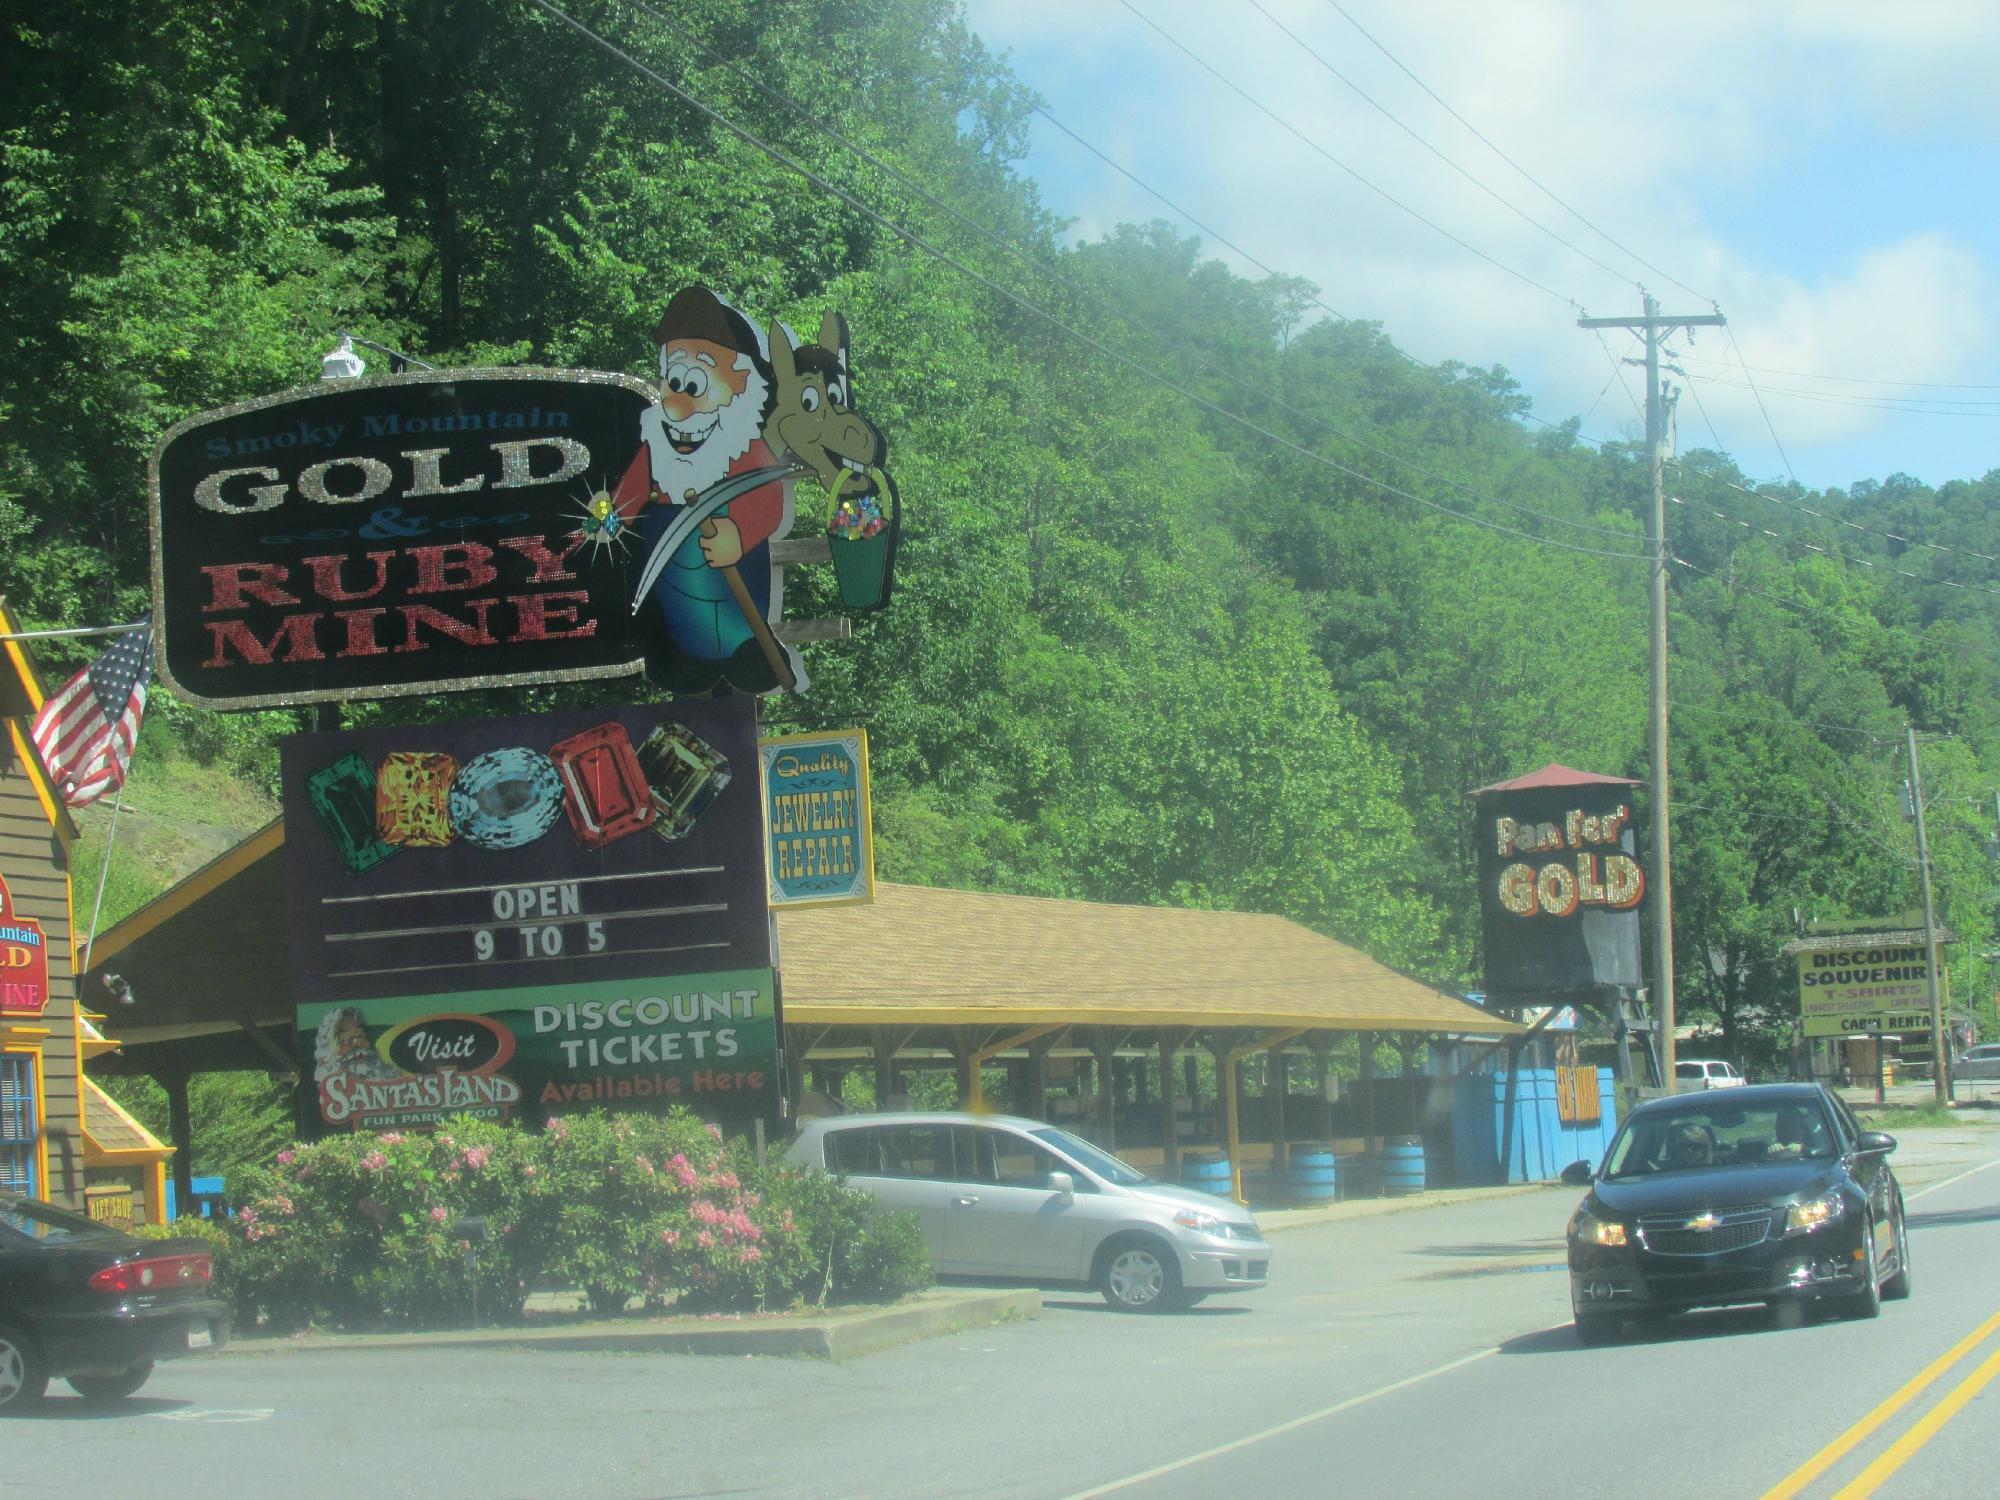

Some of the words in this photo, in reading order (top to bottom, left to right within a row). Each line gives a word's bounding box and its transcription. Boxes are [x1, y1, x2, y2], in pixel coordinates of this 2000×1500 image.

[205, 422, 344, 459] Smoky
[361, 407, 569, 437] Mountain
[193, 437, 591, 514] GOLD
[357, 507, 431, 540] &
[201, 529, 585, 612] RUBY
[202, 590, 598, 668] MINE
[776, 753, 849, 778] Quality
[772, 789, 856, 834] JEWELRY
[1496, 816, 1563, 856] Pan
[777, 835, 855, 880] REPAIR
[493, 884, 580, 920] OPEN
[1498, 852, 1645, 916] GOLD
[474, 930, 494, 961] 9
[520, 925, 563, 957] TO
[588, 921, 606, 952] 5
[1813, 948, 1929, 967] DISCOUNT
[533, 989, 760, 1034] DISCOUNT
[1824, 985, 1921, 999] T-SHIRTS
[1889, 1015, 1946, 1029] RENTAS
[408, 1031, 476, 1061] Visit
[559, 1028, 739, 1069] TICKETS
[539, 1071, 683, 1104] Available
[692, 1069, 765, 1093] Here
[364, 1115, 396, 1126] FUN
[402, 1112, 444, 1124] PARK
